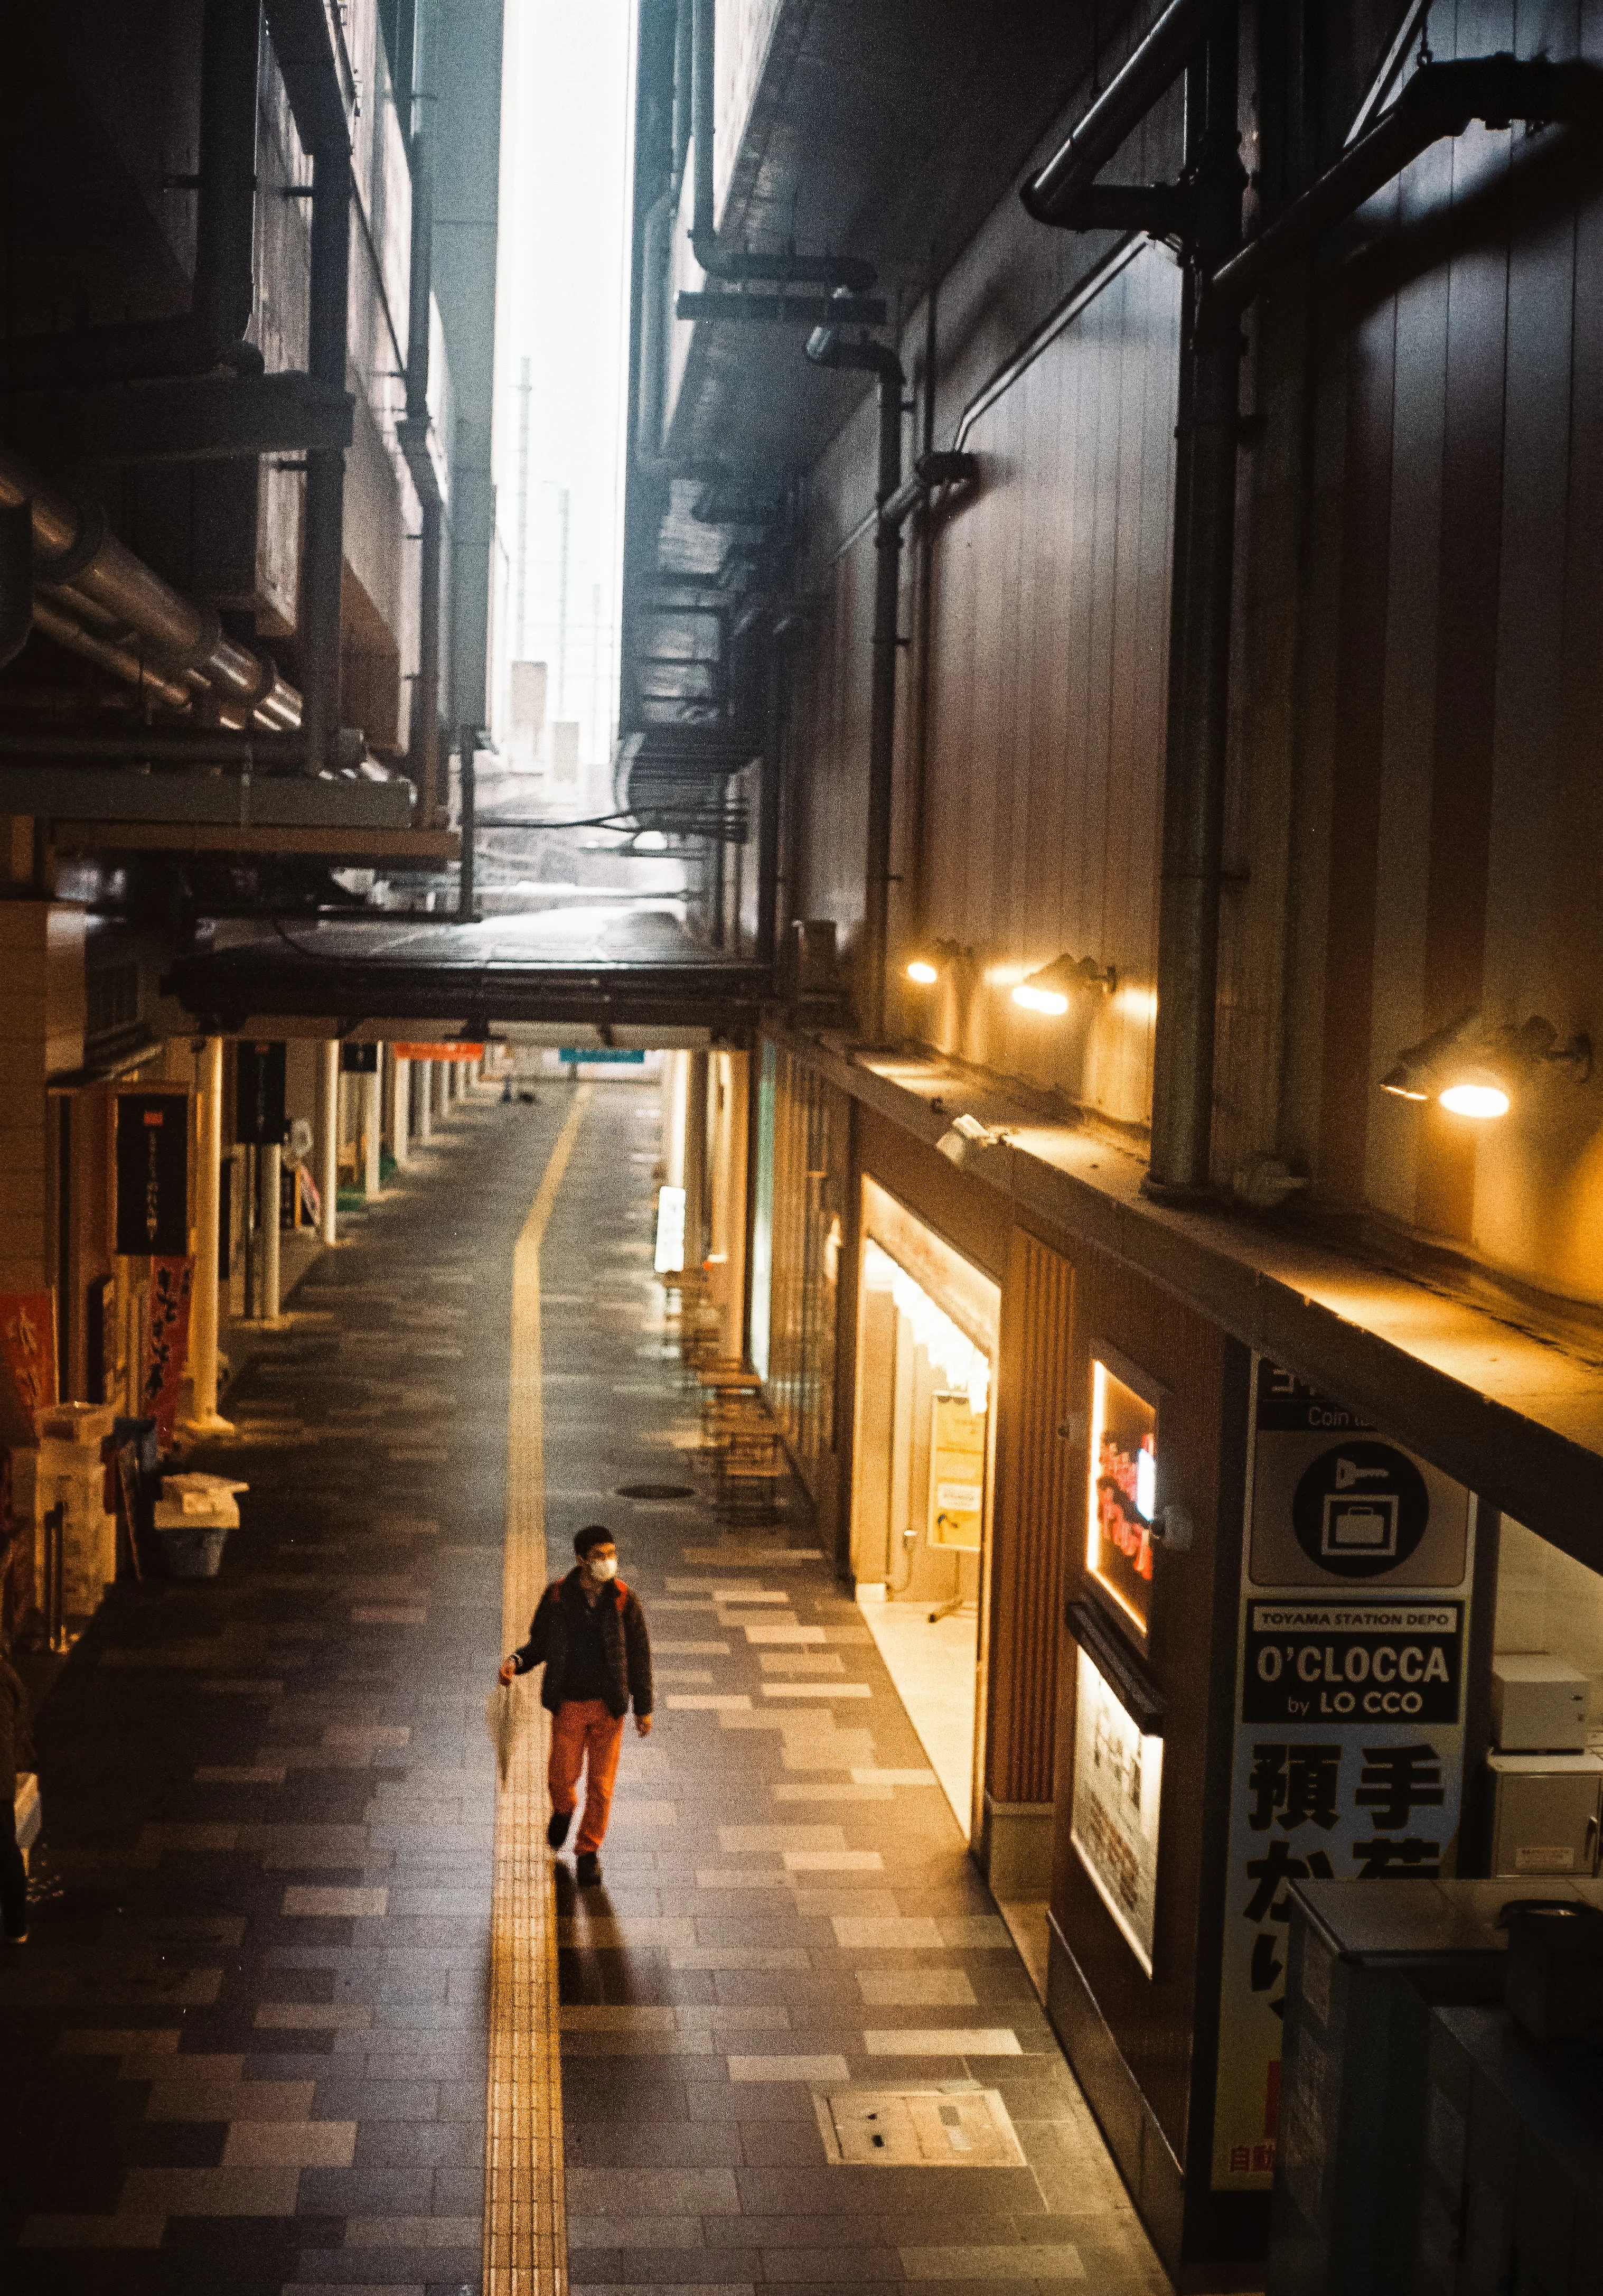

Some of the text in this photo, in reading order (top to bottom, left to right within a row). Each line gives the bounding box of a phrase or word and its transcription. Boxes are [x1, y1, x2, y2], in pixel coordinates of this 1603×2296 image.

[1308, 1406, 1349, 1426] Coin
[1261, 1613, 1449, 1626] TOYAMA STATION DEPO
[1257, 1645, 1450, 1683] O'CLOCCA
[1287, 1695, 1310, 1716] by
